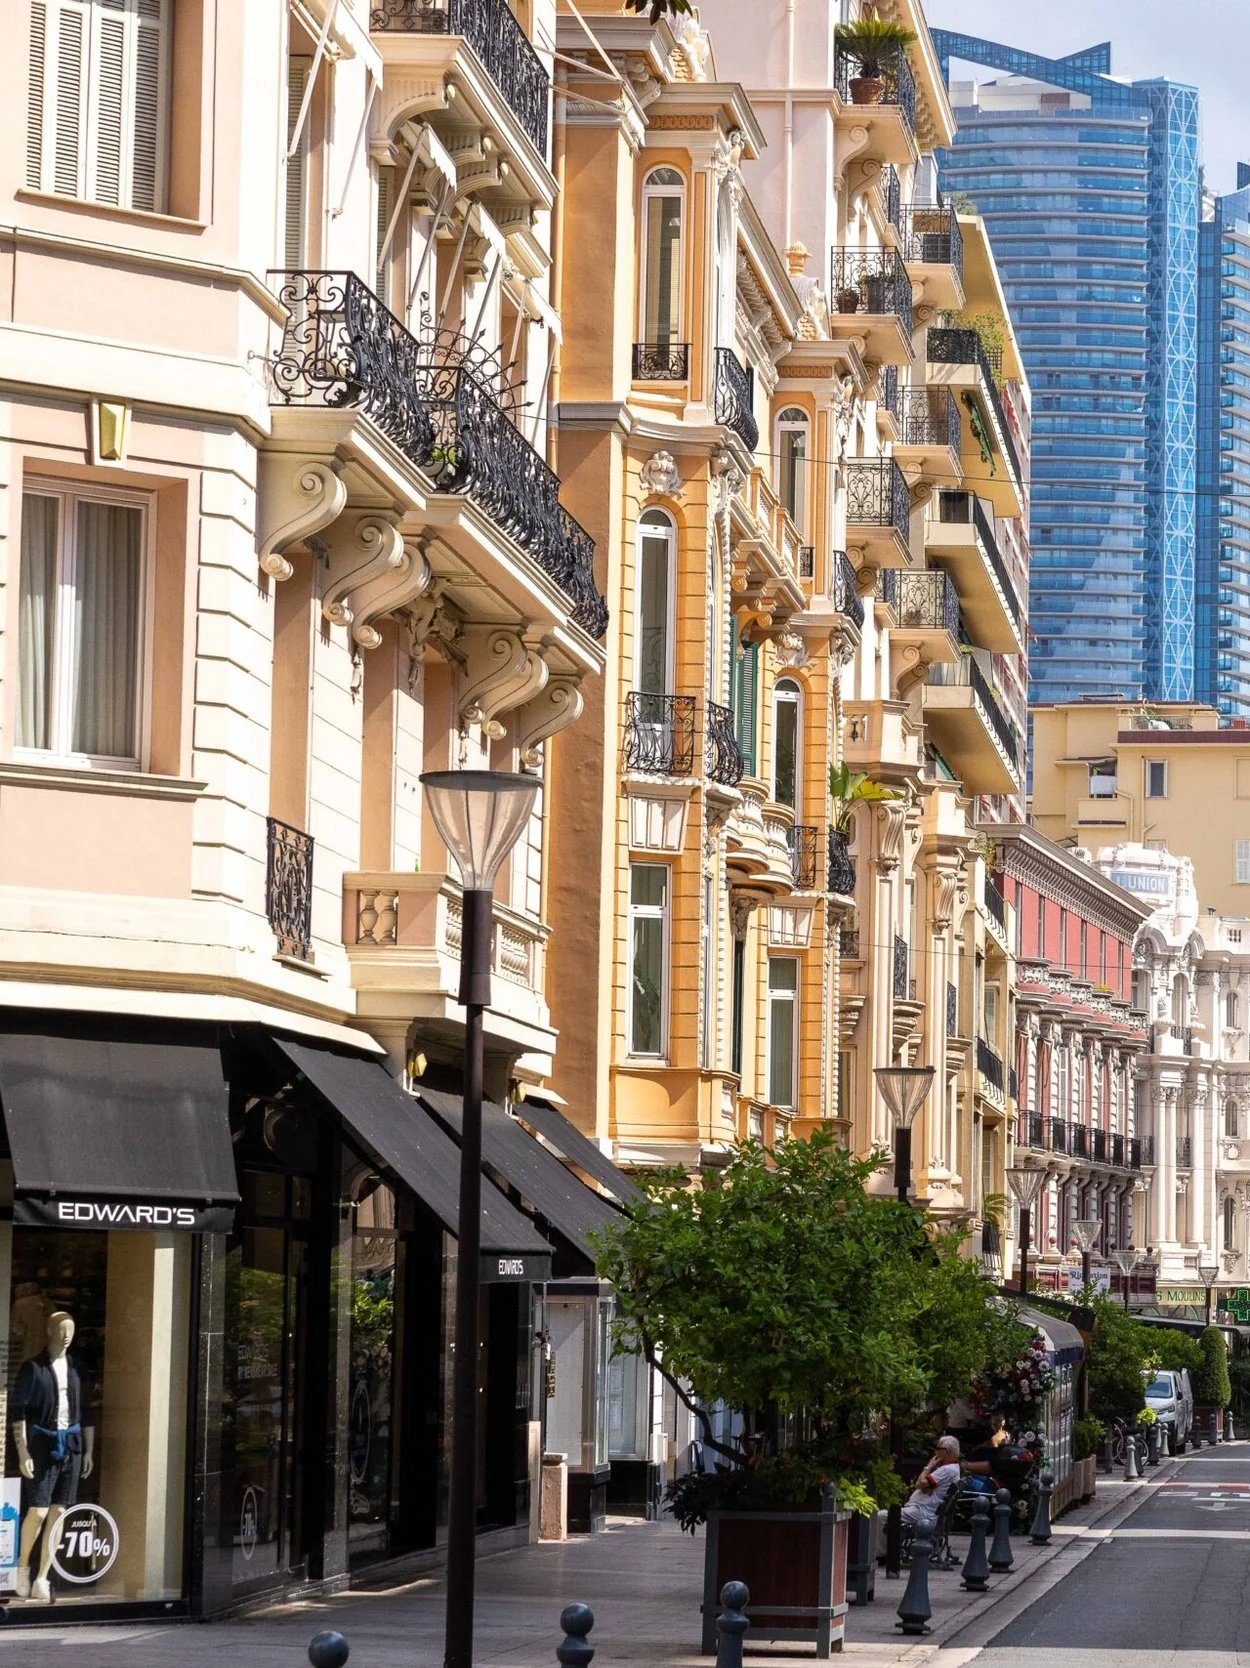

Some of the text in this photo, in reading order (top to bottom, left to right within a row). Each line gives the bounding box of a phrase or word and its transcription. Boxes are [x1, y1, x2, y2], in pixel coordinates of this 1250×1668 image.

[58, 1202, 195, 1225] EDWARD'S
[1167, 1290, 1205, 1302] MOULINS
[57, 1530, 110, 1558] -70%
